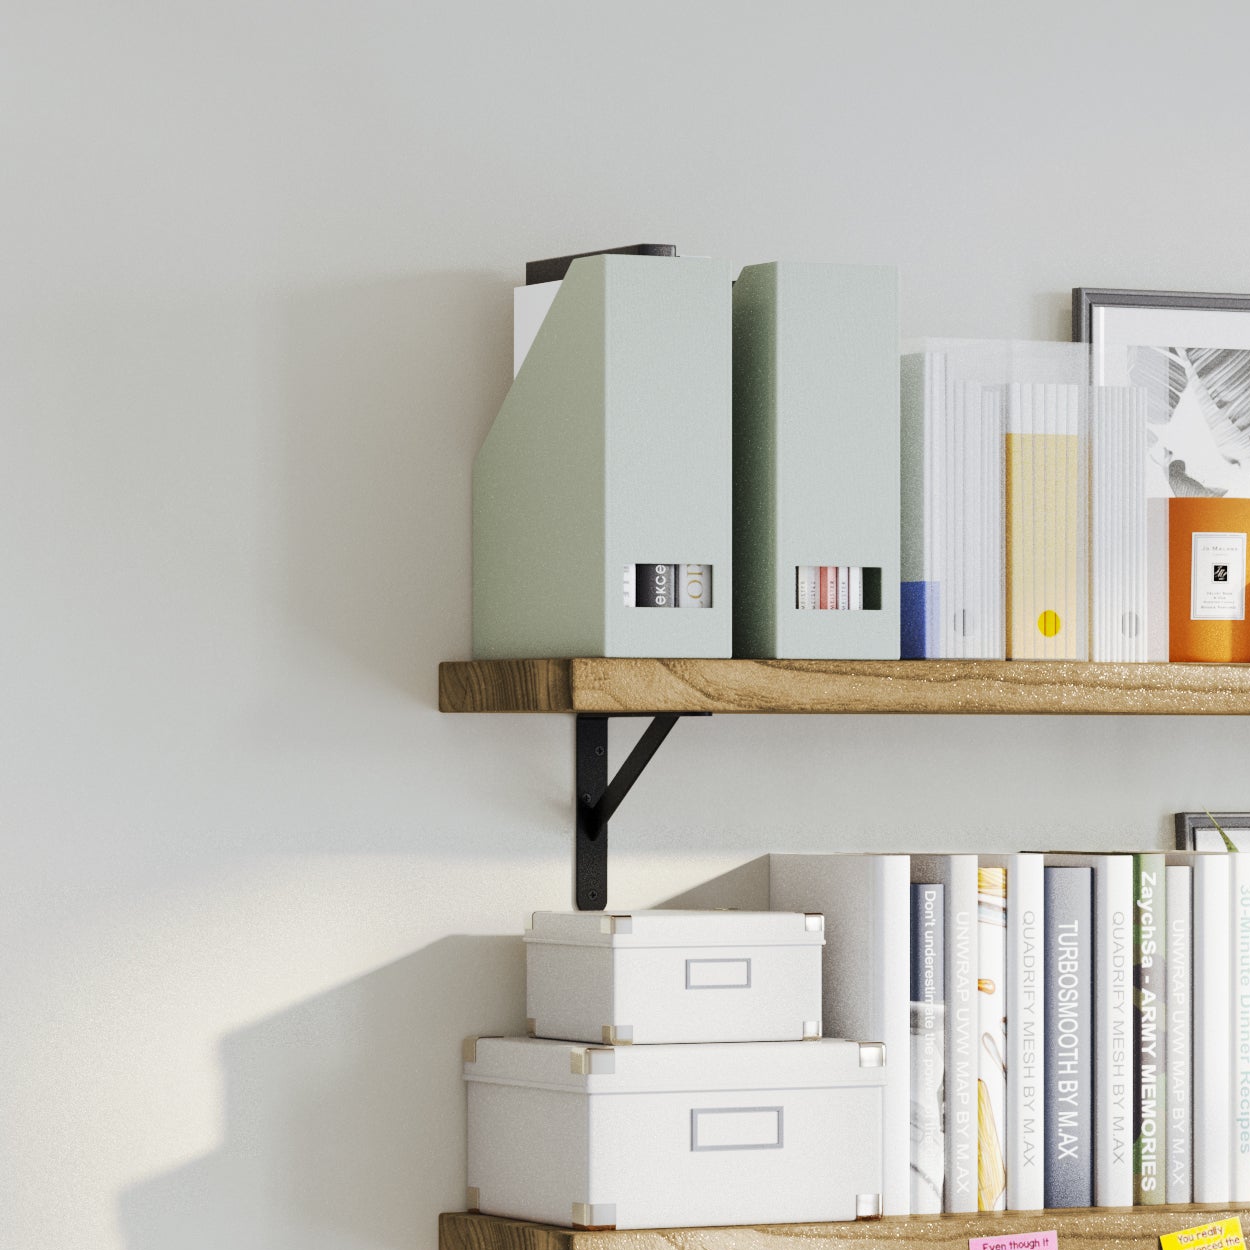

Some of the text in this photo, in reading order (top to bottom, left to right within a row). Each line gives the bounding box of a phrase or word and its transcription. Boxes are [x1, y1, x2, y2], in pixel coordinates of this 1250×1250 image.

[924, 890, 936, 926] Don't
[1137, 872, 1157, 968] ZaychSa
[924, 930, 936, 1028] underestimate
[1141, 988, 1156, 1057] ARMY
[956, 912, 970, 1194] UNWRAP UVW MAP BY M.AX
[1022, 910, 1035, 1166] QUADRIFY MESH BY M.AX
[1057, 920, 1078, 1159] TURBOSMOOTH BY M.AX
[1111, 911, 1124, 1164] QUADRIFY MESH BY M.AX
[1172, 920, 1185, 1185] UNWRAP UVW MAP BY M.AX
[1141, 1064, 1156, 1192] MEMORIES
[1010, 1239, 1039, 1250] though
[1178, 1234, 1194, 1244] You
[1226, 1237, 1240, 1246] the
